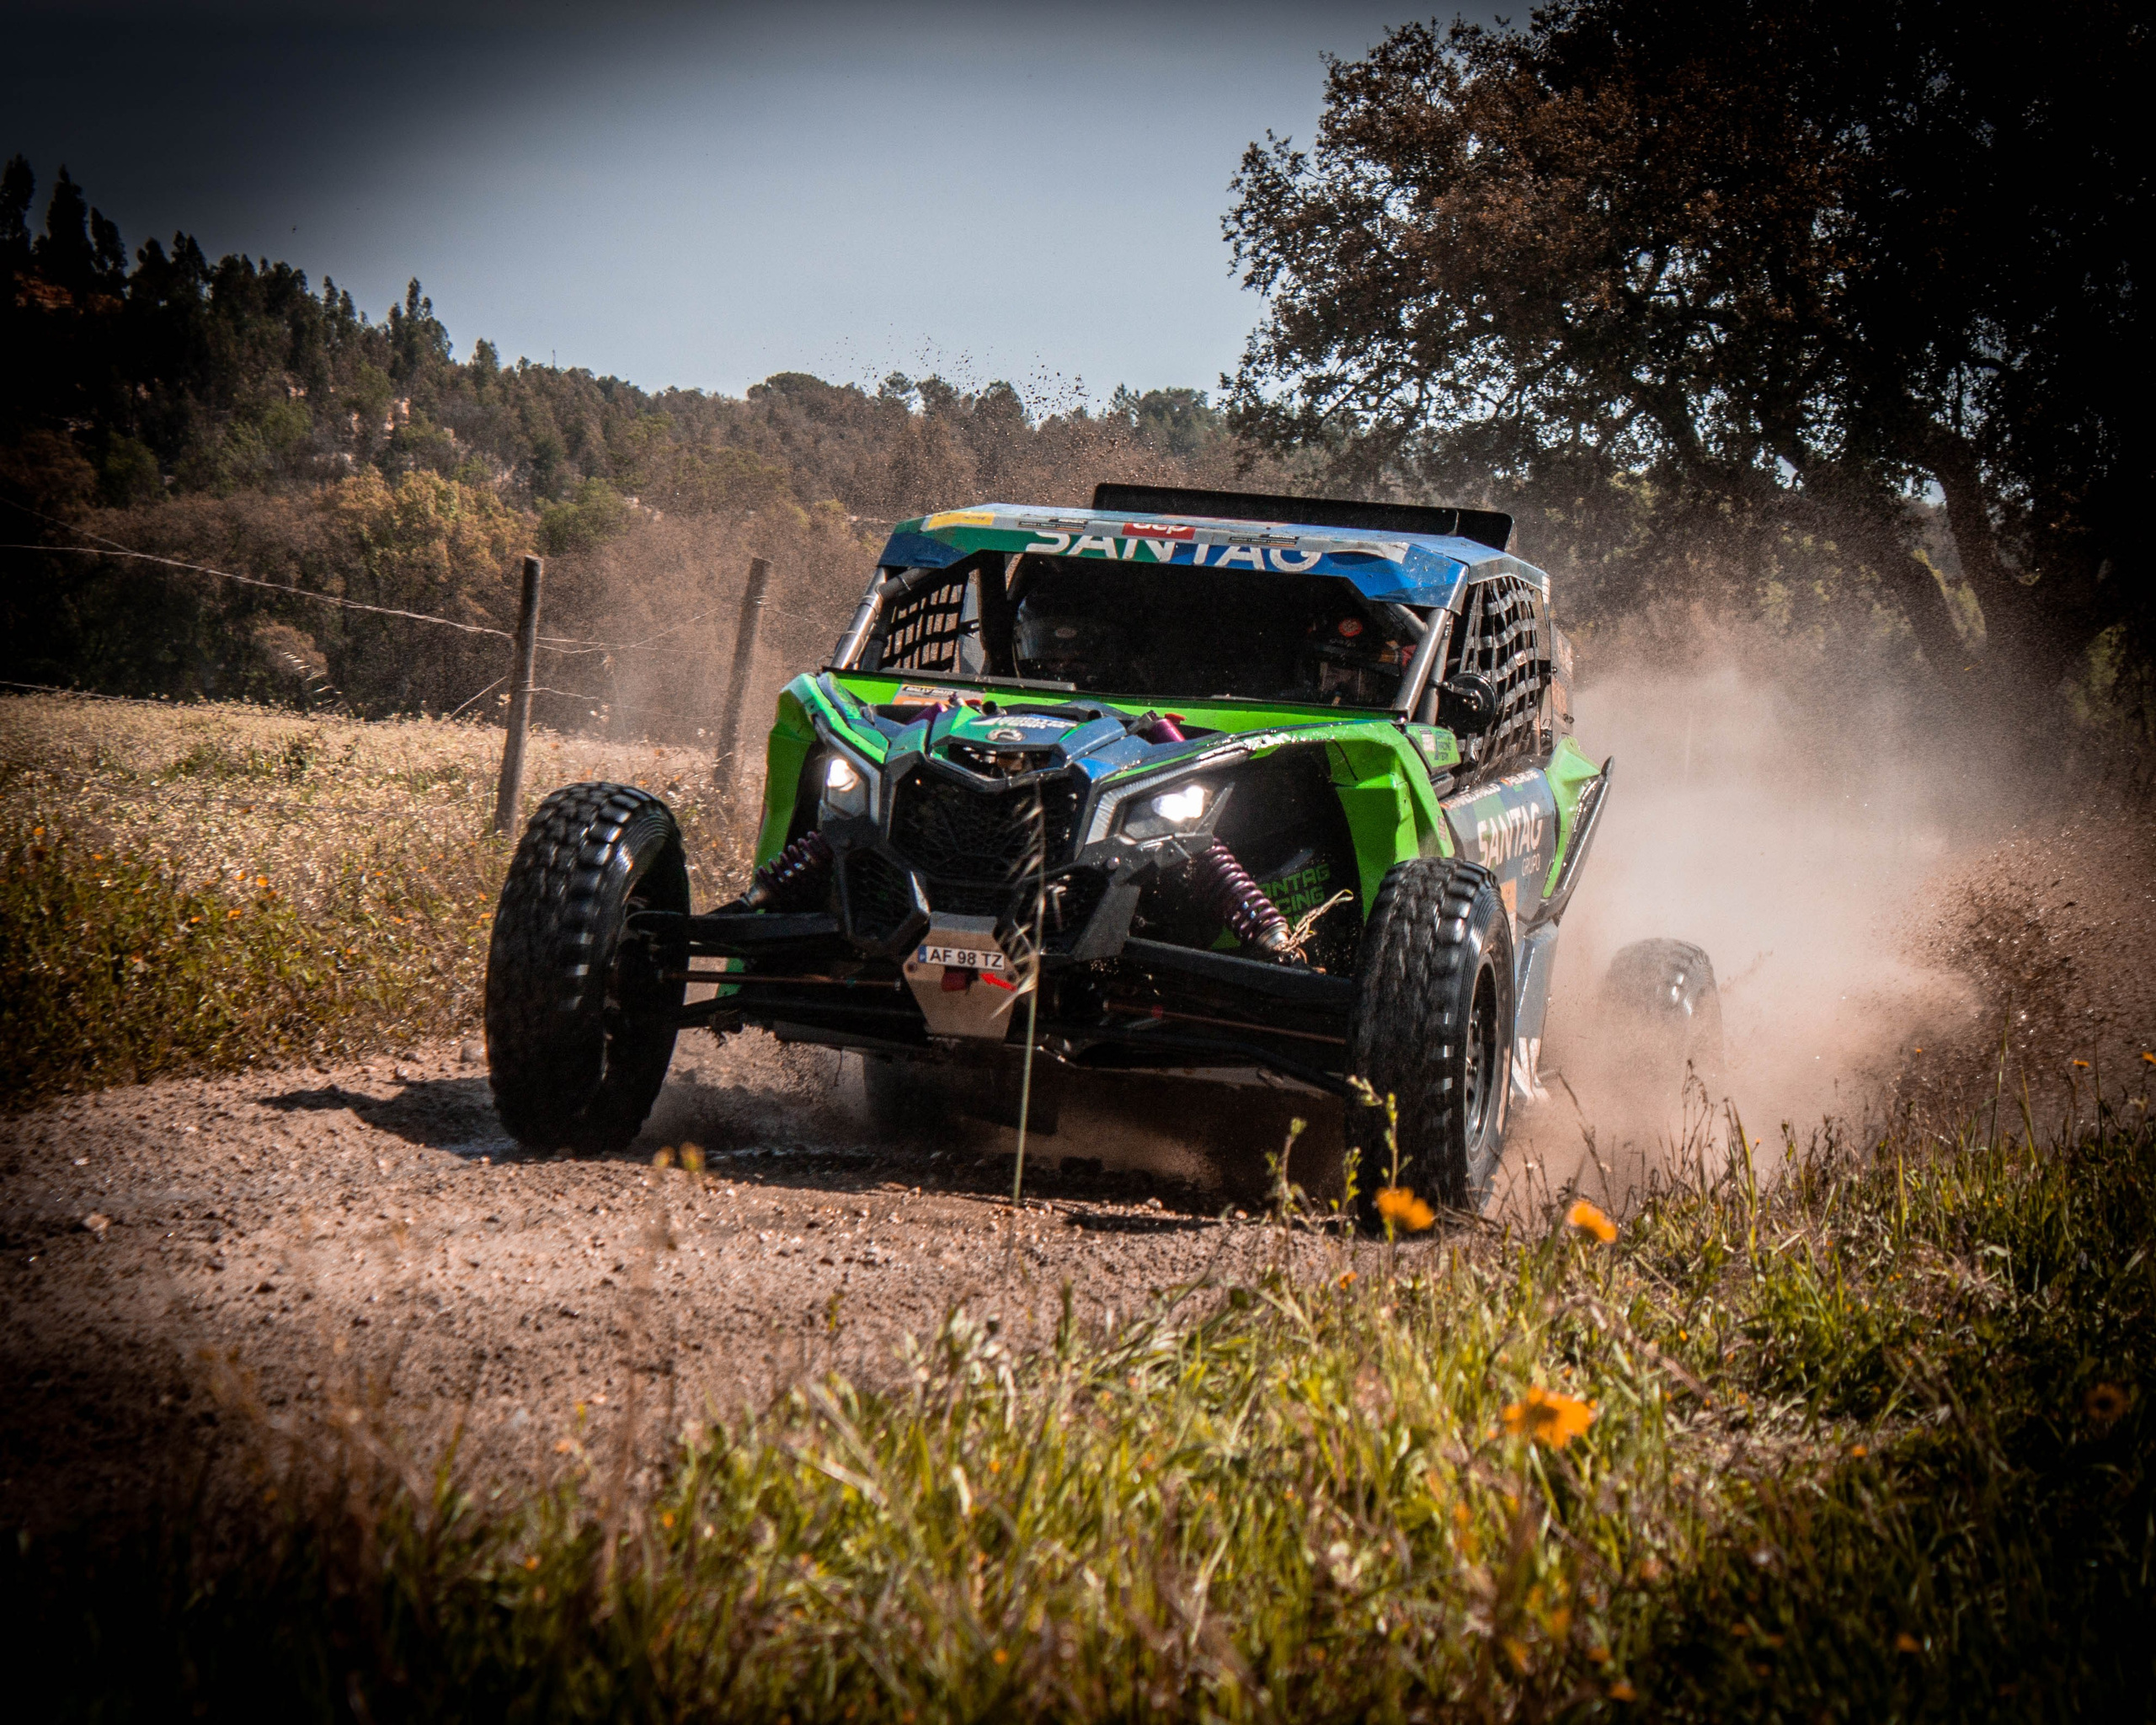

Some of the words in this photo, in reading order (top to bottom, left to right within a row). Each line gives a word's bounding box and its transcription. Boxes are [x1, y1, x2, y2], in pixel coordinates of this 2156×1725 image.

[1026, 531, 1322, 573] SANTAG
[1477, 802, 1543, 870] SANTAG
[1257, 862, 1331, 899] ANTAG
[1522, 852, 1540, 877] GRUPO
[1248, 884, 1326, 916] CING
[930, 948, 953, 963] AF
[957, 950, 977, 966] 98
[980, 952, 1002, 969] TZ
